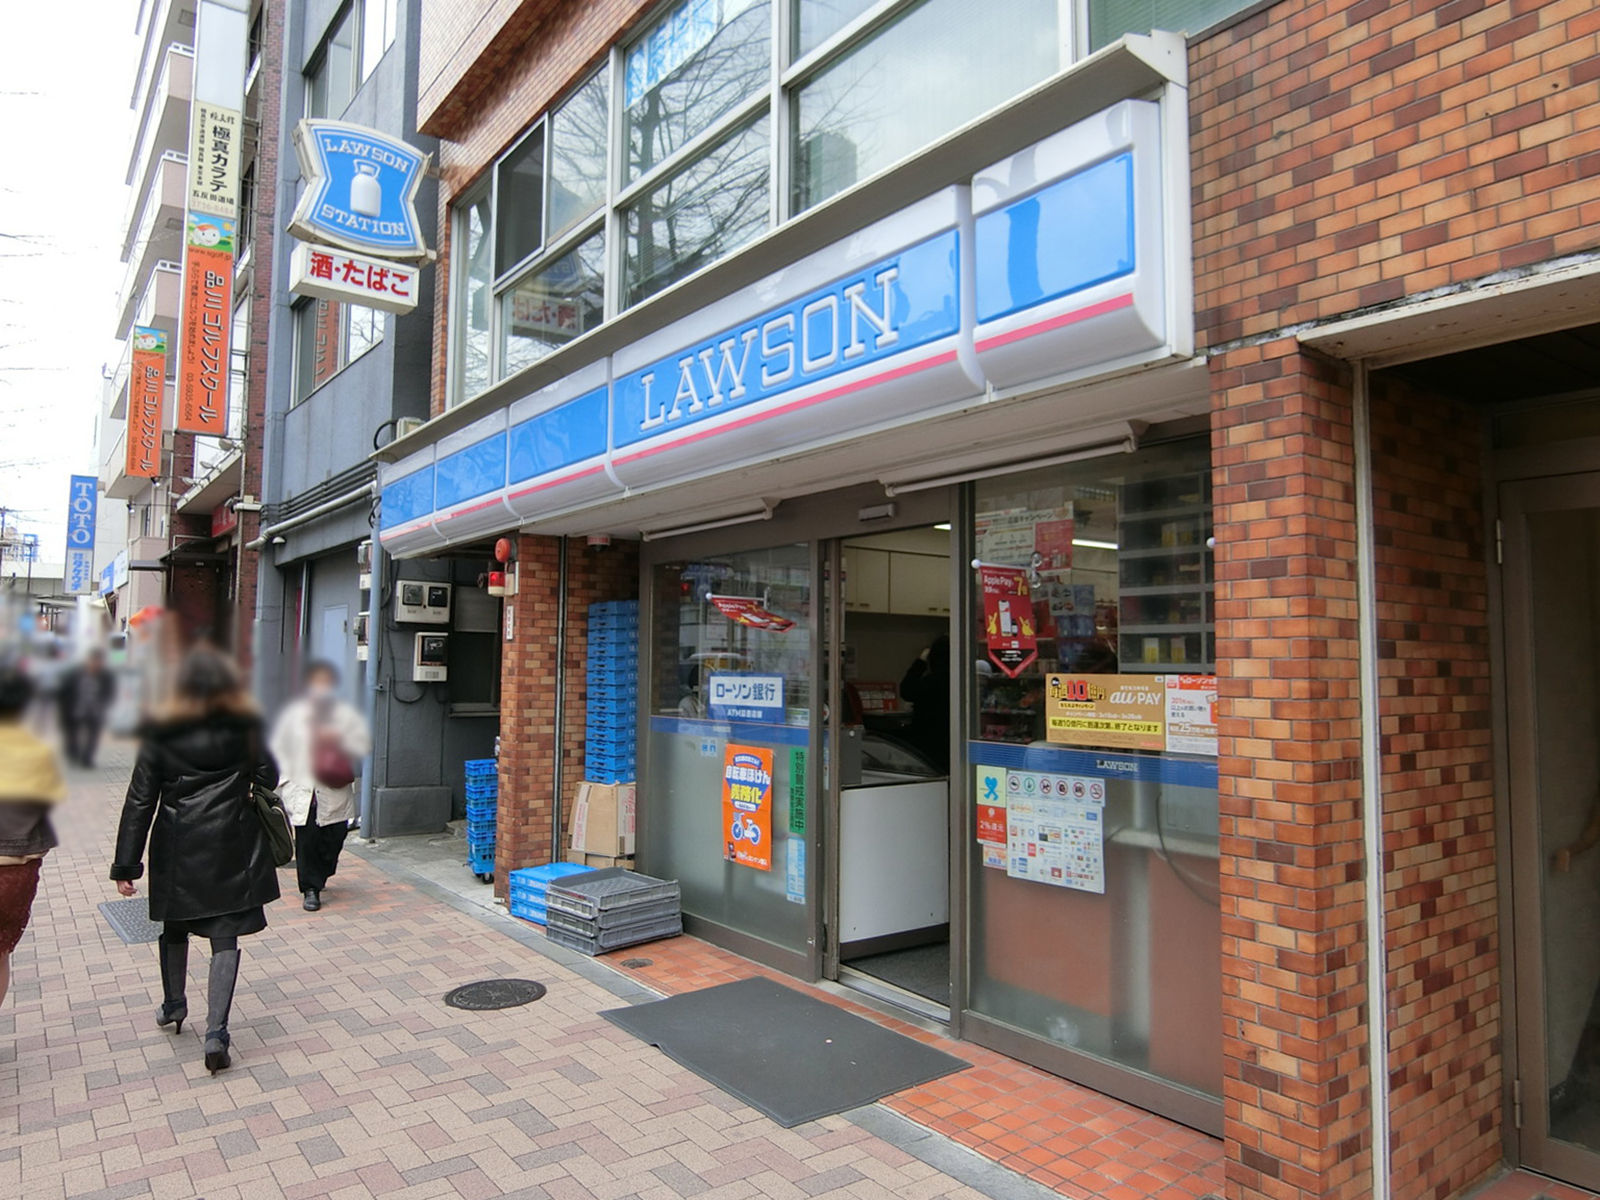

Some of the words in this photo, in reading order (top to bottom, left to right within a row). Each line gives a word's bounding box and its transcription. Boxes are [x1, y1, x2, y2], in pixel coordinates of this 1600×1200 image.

[210, 125, 231, 192] 極真カラテ
[324, 138, 409, 173] LAWSON
[320, 203, 407, 237] STATION
[309, 251, 410, 298] 酒・たばこ
[198, 269, 226, 424] 品川ゴルフスクール
[640, 267, 899, 431] LAWSON
[71, 482, 94, 544] TOTO
[715, 683, 776, 701] ローソン銀行
[1110, 691, 1137, 704] au
[1137, 692, 1162, 705] PAY
[725, 765, 771, 785] 自転車ほけん
[1096, 759, 1139, 773] LAWSON
